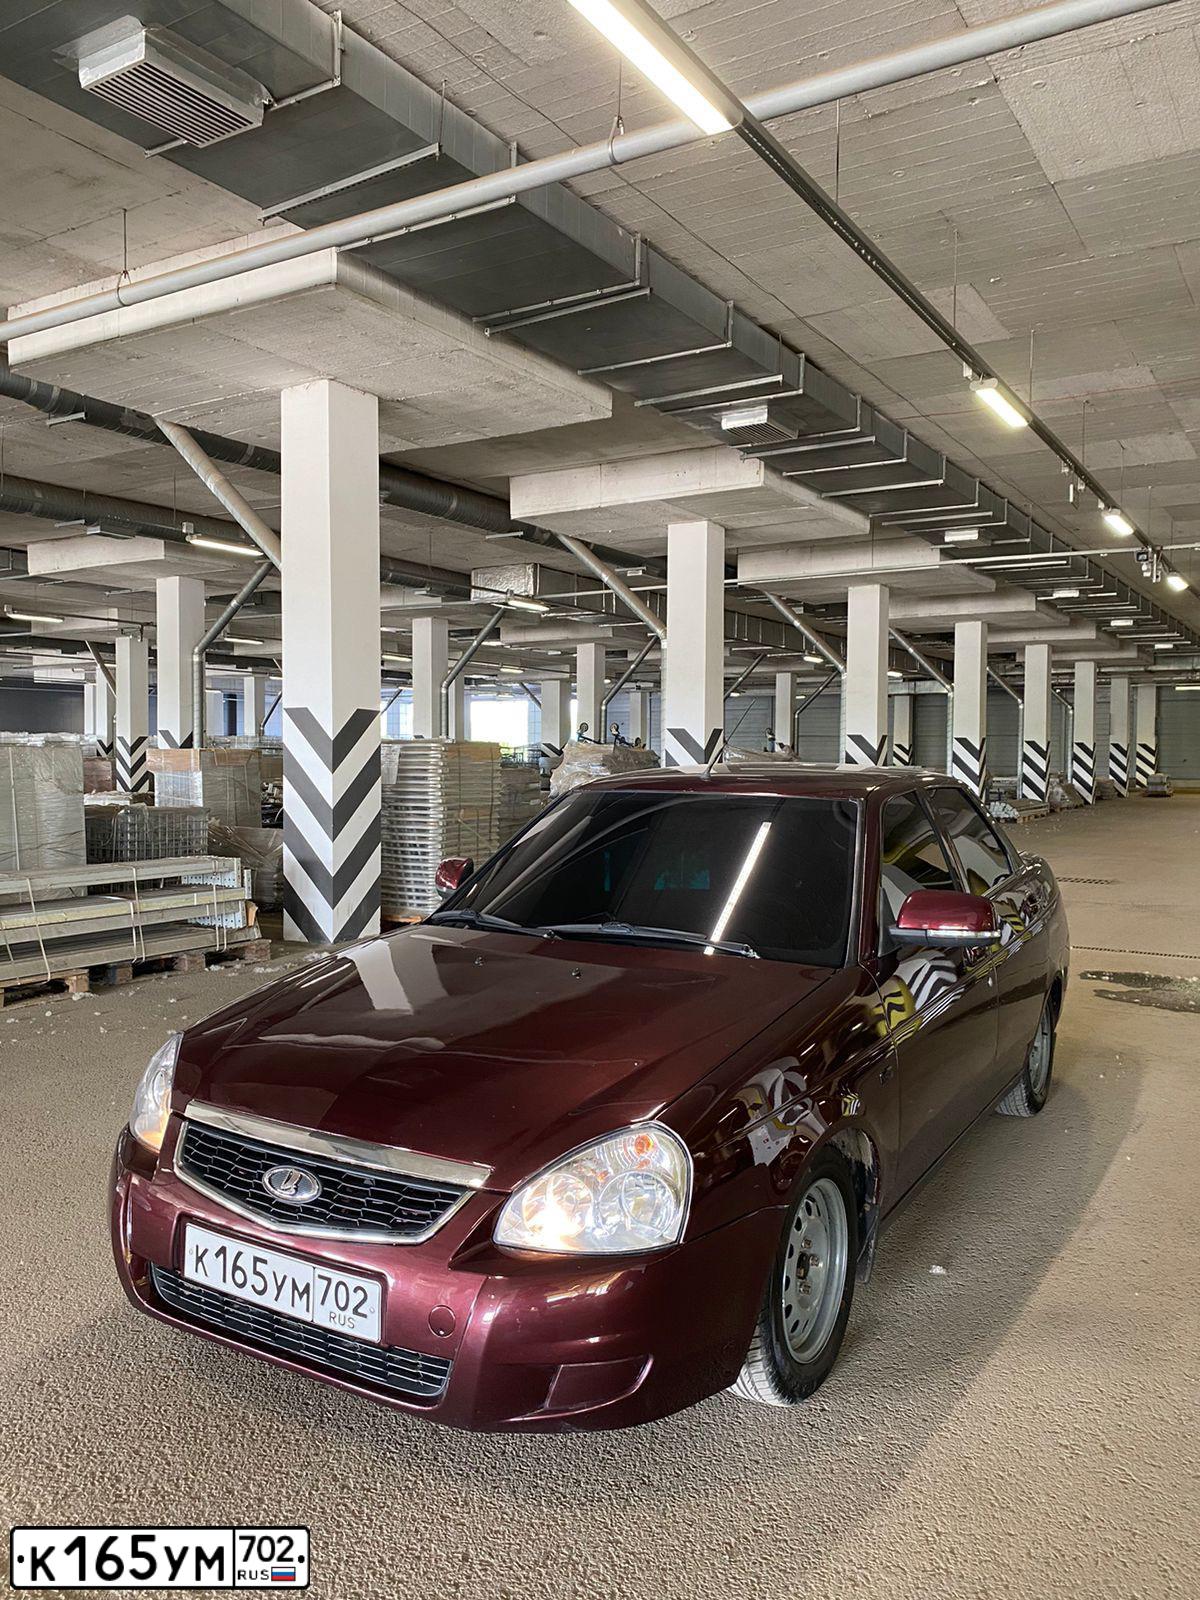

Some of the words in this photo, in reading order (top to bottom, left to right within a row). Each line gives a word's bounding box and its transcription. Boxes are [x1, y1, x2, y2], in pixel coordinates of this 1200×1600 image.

[194, 1244, 311, 1313] К165УМ
[317, 1274, 369, 1319] 702
[329, 1311, 355, 1329] RUS
